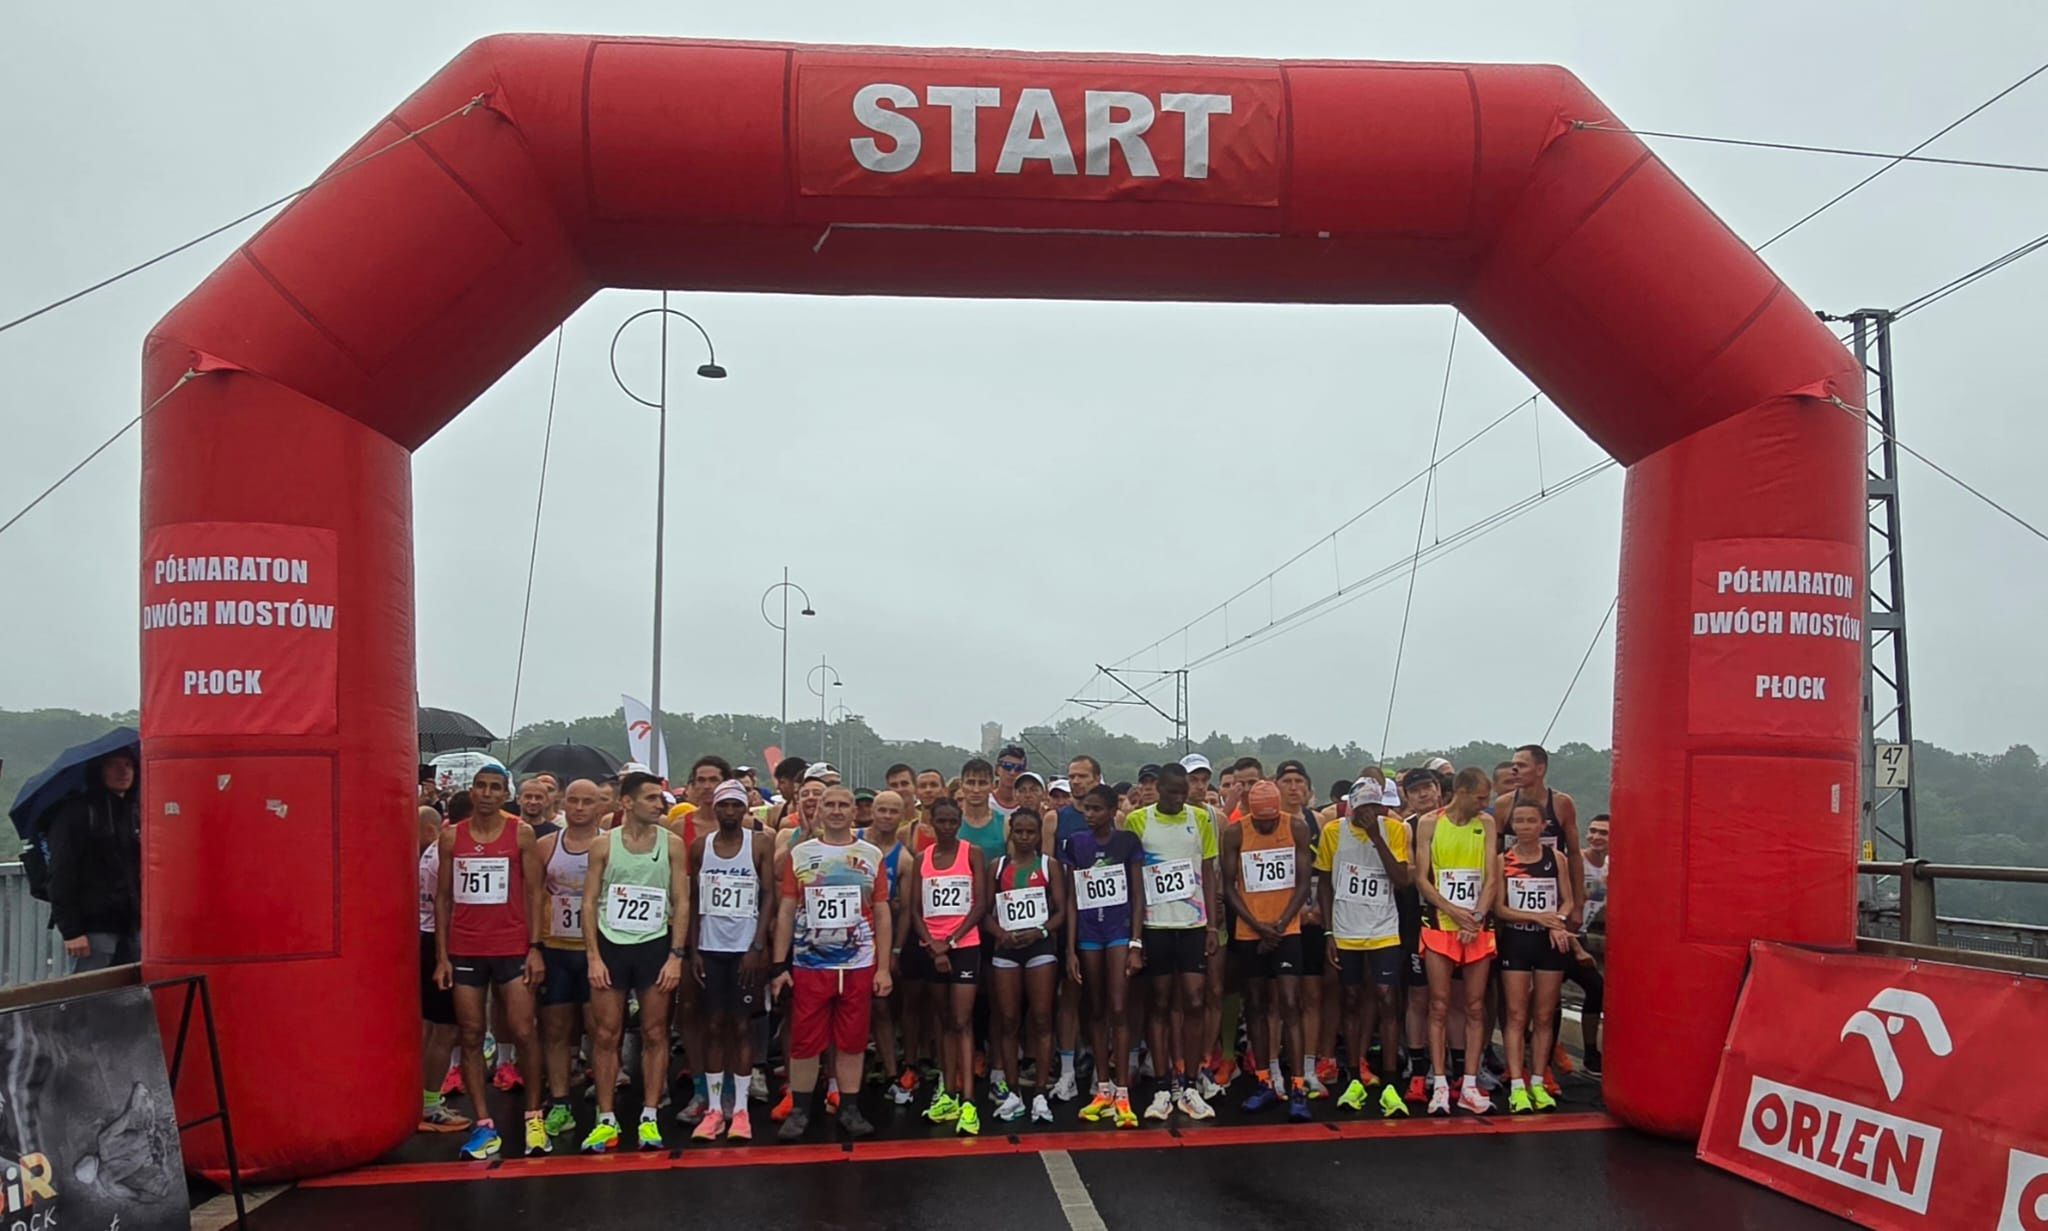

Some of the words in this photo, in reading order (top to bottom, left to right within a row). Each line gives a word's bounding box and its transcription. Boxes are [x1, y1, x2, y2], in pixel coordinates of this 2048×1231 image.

[849, 83, 1233, 179] START
[154, 554, 309, 585] PÓŁMARATON
[1717, 566, 1854, 599] PÓŁMARATON
[143, 598, 208, 631] DWÓCH
[214, 598, 335, 631] MOSTÓW
[1692, 606, 1784, 636] DWÓCH
[1789, 611, 1861, 642] MOSTÓW
[183, 669, 263, 696] PŁOCK
[1755, 675, 1826, 702] PŁOCK
[1882, 747, 1904, 765] 47
[1886, 768, 1898, 785] 7
[1255, 861, 1286, 882] 736
[459, 872, 491, 894] 751
[1086, 877, 1117, 900] 603
[1155, 872, 1186, 894] 623
[1348, 876, 1379, 898] 619
[1446, 881, 1476, 901] 754
[711, 888, 742, 908] 621
[932, 888, 961, 908] 622
[1516, 891, 1547, 910] 755
[616, 898, 651, 921] 722
[817, 899, 848, 920] 251
[1006, 900, 1037, 922] 620
[1751, 1092, 1926, 1196] ORLEN
[0, 1151, 59, 1216] iR
